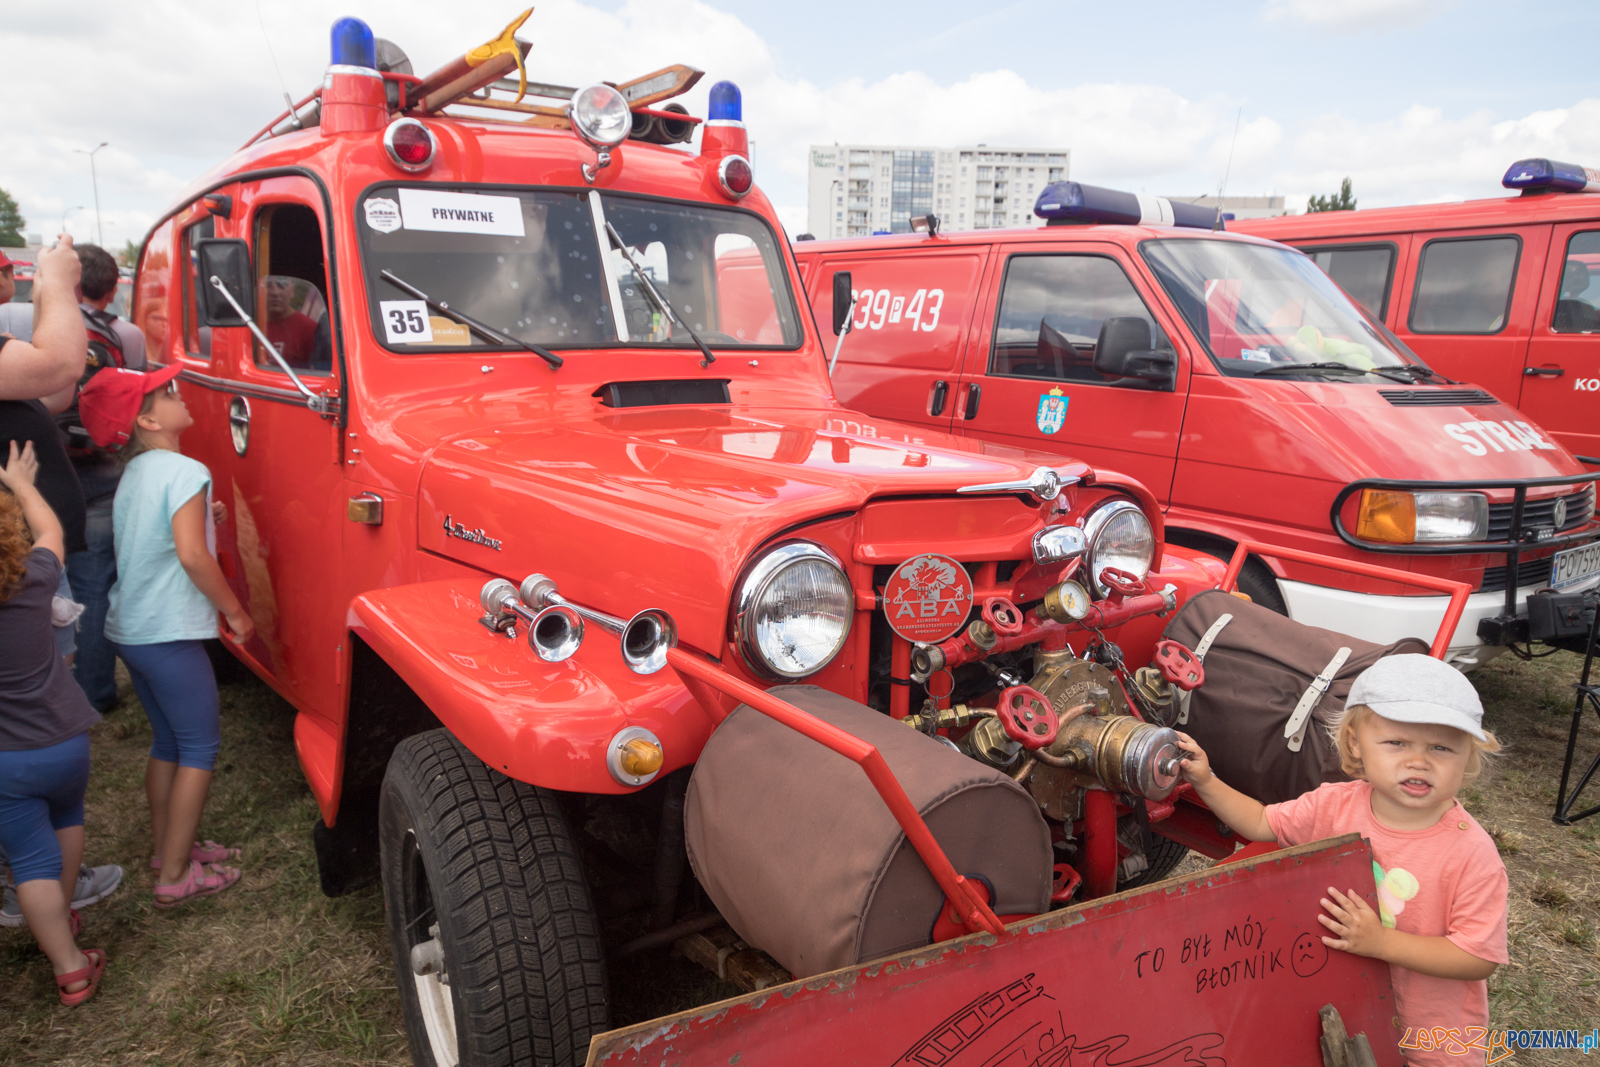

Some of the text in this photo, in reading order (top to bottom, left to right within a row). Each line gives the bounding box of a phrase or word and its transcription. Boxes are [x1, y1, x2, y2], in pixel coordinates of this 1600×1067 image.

[432, 207, 494, 223] PRYWATNE
[389, 310, 425, 334] 35
[1574, 378, 1600, 391] KO
[1558, 552, 1575, 581] PO
[1576, 546, 1600, 576] 7599
[895, 598, 961, 619] ABA
[1134, 915, 1268, 978] TO BYŁ MÓJ
